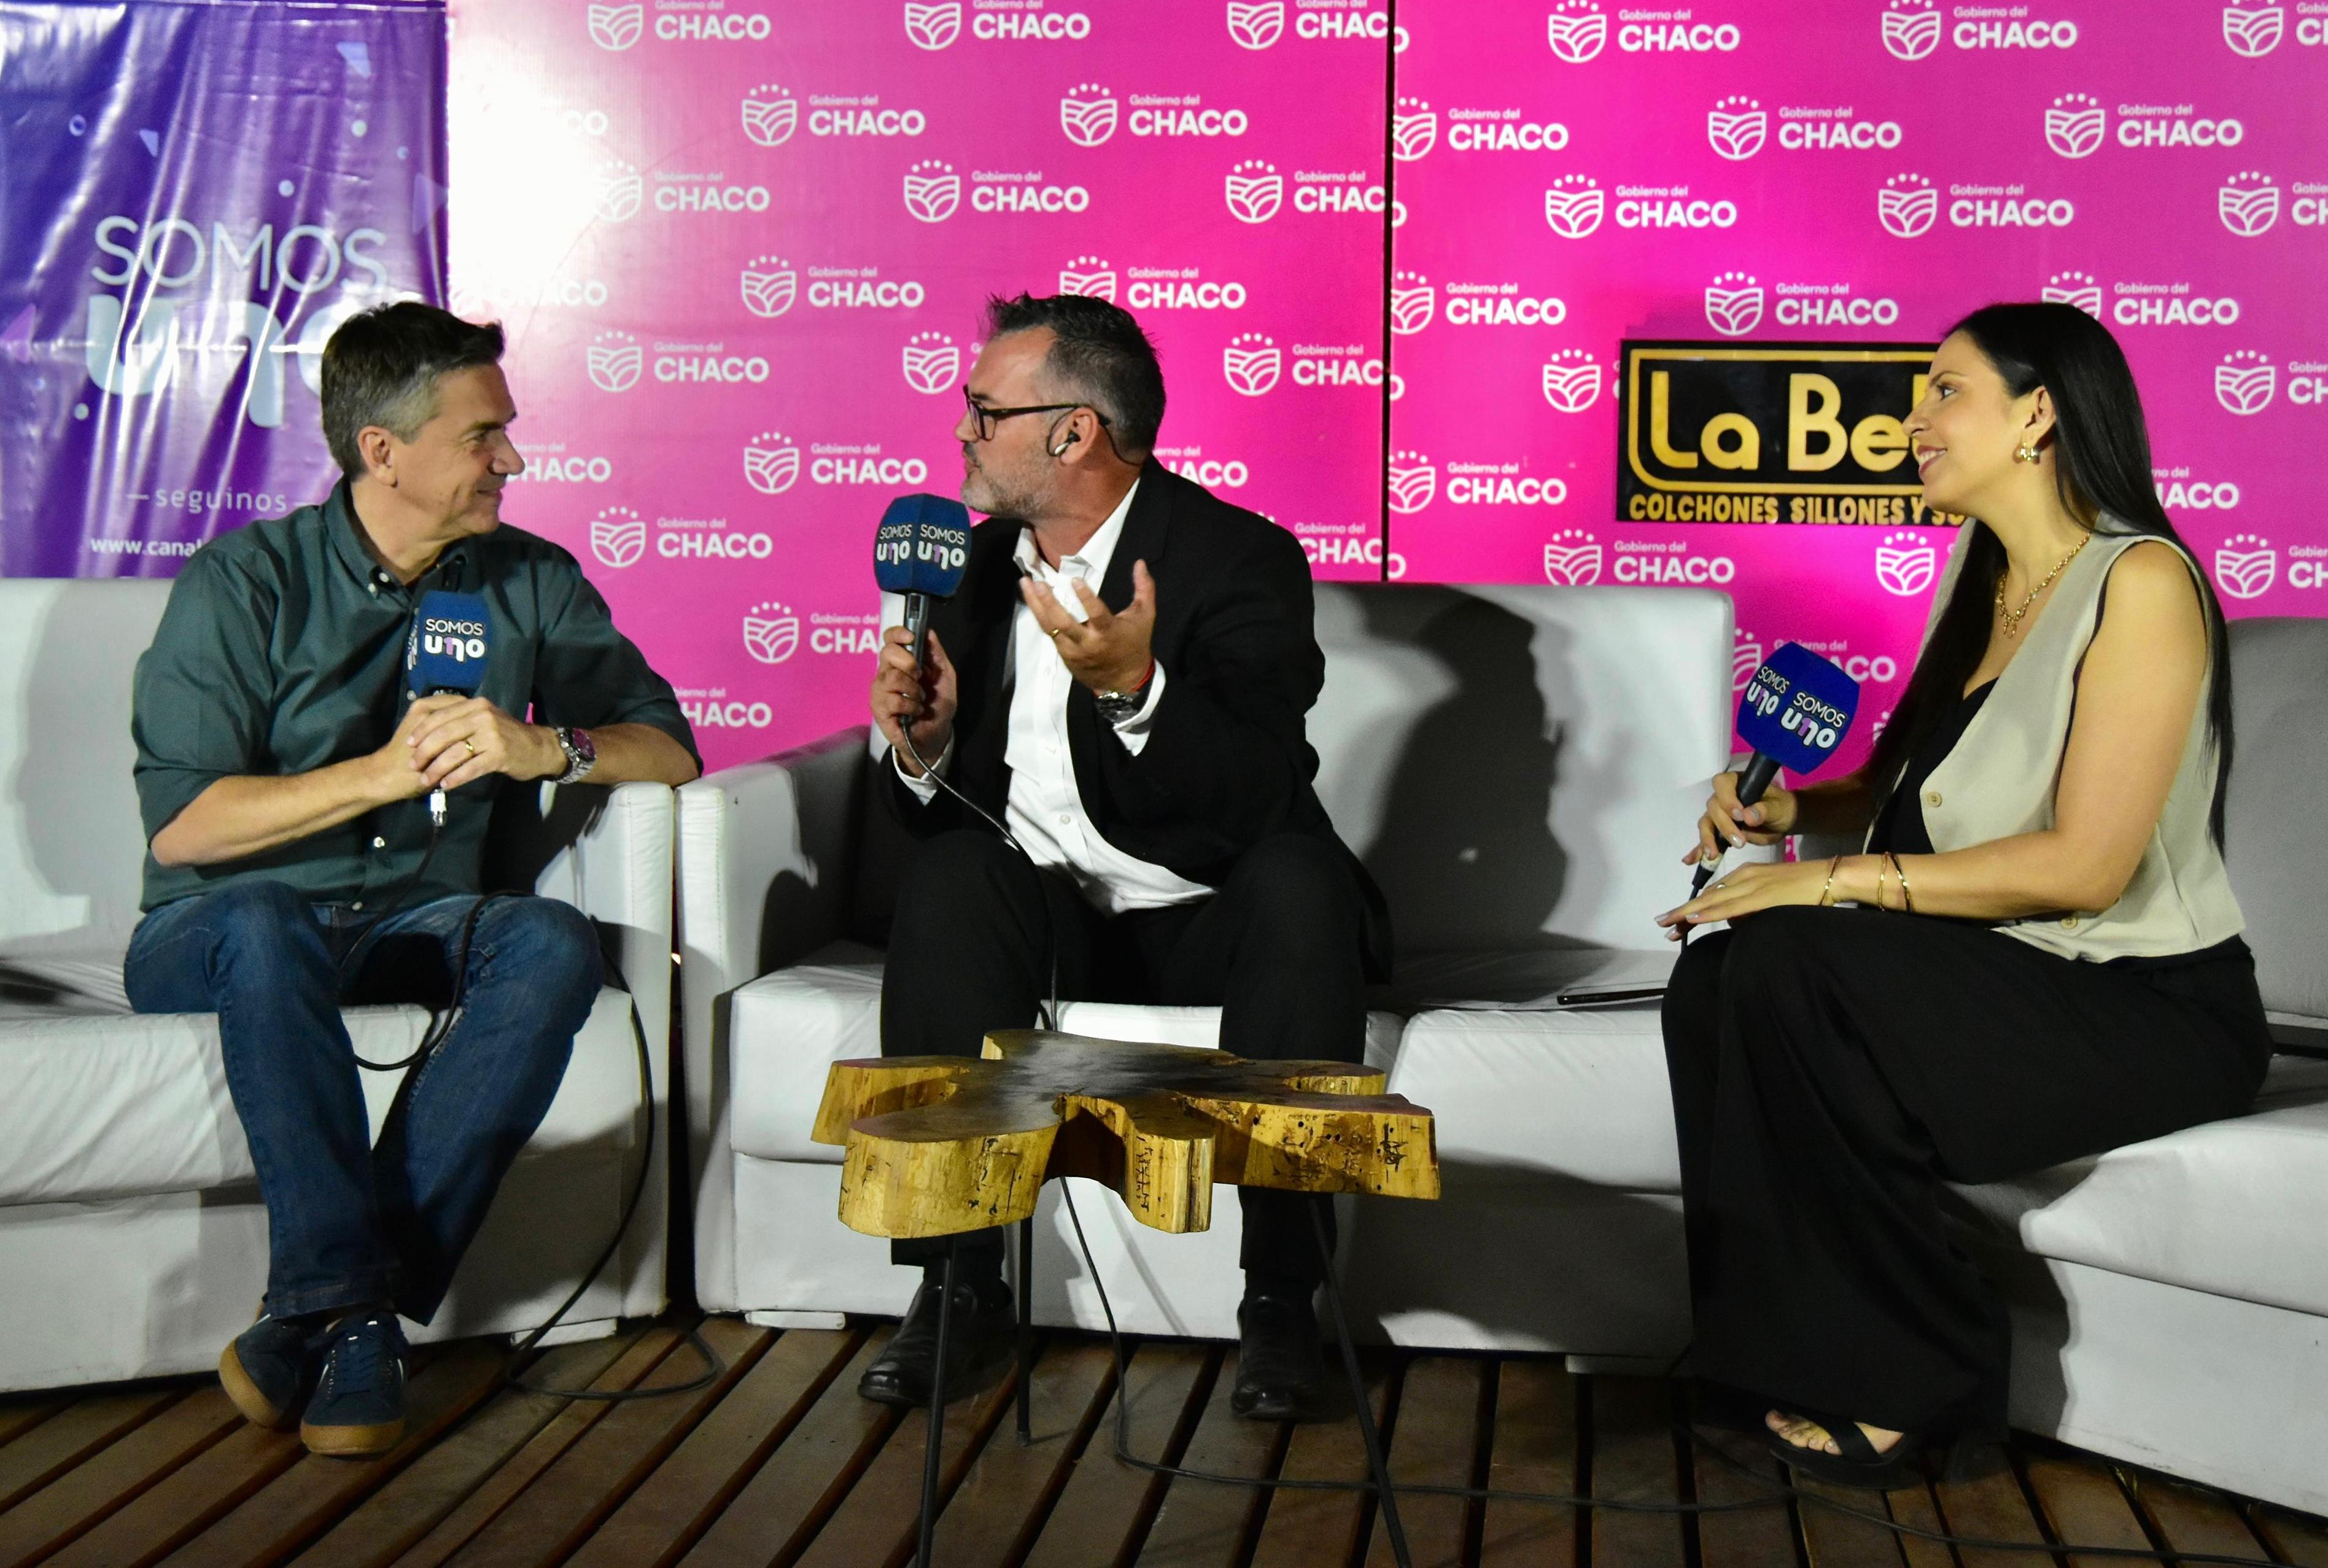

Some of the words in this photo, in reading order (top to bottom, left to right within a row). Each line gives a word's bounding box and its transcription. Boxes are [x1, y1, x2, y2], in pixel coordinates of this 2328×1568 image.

[1618, 9, 1672, 21] Gobierno
[1672, 10, 1691, 20] del
[1954, 6, 2008, 18] Gobierno
[2009, 6, 2028, 17] del
[654, 14, 770, 41] CHACO
[972, 13, 1090, 39] CHACO
[1296, 12, 1388, 39] CHAC
[1618, 24, 1740, 52] CHACO
[1954, 21, 2078, 49] CHACO
[809, 95, 858, 106] Gobierno
[861, 95, 879, 106] del
[1130, 94, 1181, 106] Gobierno
[1182, 95, 1200, 106] del
[1779, 107, 1833, 118] Gobierno
[1834, 107, 1852, 118] del
[2118, 104, 2172, 115] Gobierno
[2174, 104, 2193, 115] del
[809, 110, 925, 136] CHACO
[1129, 109, 1247, 136] CHACO
[1449, 108, 1501, 120] Gobierno
[1502, 109, 1520, 119] del
[1448, 123, 1569, 150] CHACO
[1779, 122, 1902, 149] CHACO
[2117, 119, 2243, 147] CHACO
[972, 171, 1023, 182] Gobierno
[1025, 172, 1042, 182] del
[1294, 171, 1346, 182] Gobierno
[1348, 171, 1365, 182] del
[654, 186, 770, 212] CHACO
[972, 186, 1089, 212] CHACO
[1294, 186, 1385, 212] CHAC
[1616, 185, 1669, 197] Gobierno
[1670, 186, 1688, 196] del
[1950, 184, 2004, 196] Gobierno
[2006, 185, 2024, 195] del
[1616, 201, 1737, 228] CHACO
[1950, 200, 2074, 227] CHACO
[91, 215, 388, 293] SOMOS
[808, 266, 858, 278] Gobierno
[859, 267, 877, 277] del
[1128, 267, 1179, 278] Gobierno
[1181, 268, 1198, 278] del
[808, 281, 924, 308] CHACO
[1128, 282, 1246, 309] CHACO
[1446, 282, 1499, 294] Gobierno
[1500, 283, 1518, 294] del
[1776, 283, 1829, 295] Gobierno
[1831, 284, 1849, 294] del
[2114, 282, 2169, 294] Gobierno
[2170, 283, 2189, 293] del
[1446, 298, 1566, 325] CHACO
[1776, 298, 1898, 325] CHACO
[2114, 298, 2239, 325] CHACO
[653, 342, 704, 353] Gobierno
[705, 343, 723, 353] del
[1292, 344, 1344, 355] Gobierno
[1346, 344, 1364, 355] del
[654, 356, 769, 382] CHACO
[1292, 359, 1383, 386] CHAC
[1651, 371, 1760, 471] La
[811, 443, 861, 454] Gobierno
[863, 444, 880, 454] del
[1184, 446, 1201, 457] del
[507, 457, 611, 483] HACO
[811, 458, 927, 484] CHACO
[1169, 460, 1249, 487] ACO
[1448, 462, 1499, 473] Gobierno
[1500, 464, 1519, 474] del
[2171, 467, 2189, 478] del
[156, 487, 287, 514] seguinos
[1447, 477, 1567, 504] CHACO
[2155, 482, 2240, 509] ACO
[1630, 493, 1779, 524] COLCHONES
[1791, 496, 1905, 526] SILLONES
[1911, 496, 1926, 524] Y
[657, 518, 707, 528] Gobierno
[709, 519, 726, 529] del
[879, 524, 913, 540] SOMOS
[920, 524, 966, 545] SOMOS
[1294, 522, 1346, 534] Gobierno
[1348, 523, 1365, 534] del
[658, 532, 772, 558] CHACO
[1614, 540, 1667, 553] Gobierno
[1668, 542, 1686, 553] del
[1614, 557, 1734, 583] CHACO
[425, 619, 484, 636] SOMOS
[810, 613, 861, 624] Gobierno
[863, 614, 879, 624] del
[810, 628, 879, 654] CHA
[1829, 640, 1847, 651] del
[708, 687, 726, 697] del
[1758, 666, 1790, 694] SOMOS
[681, 702, 772, 728] HACO
[1793, 692, 1846, 728] SOMOS
